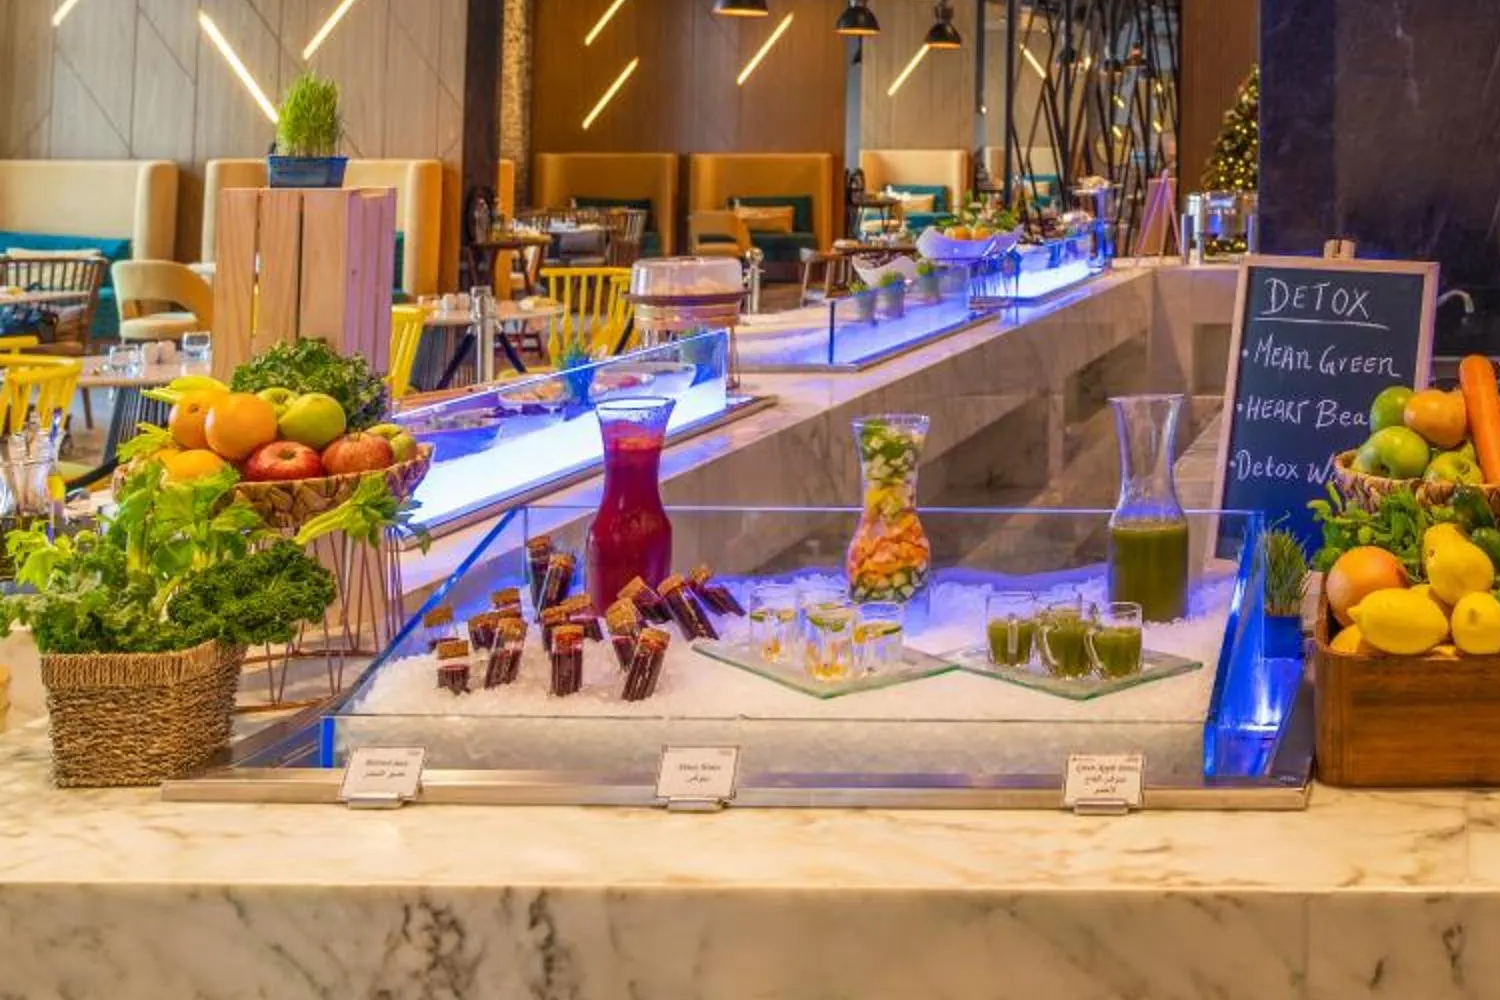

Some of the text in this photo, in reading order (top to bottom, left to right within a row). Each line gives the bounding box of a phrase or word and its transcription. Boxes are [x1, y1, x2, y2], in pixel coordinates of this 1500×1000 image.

[1260, 277, 1370, 319] DETOX
[1316, 399, 1369, 430] Bea
[1236, 449, 1299, 480] Detox
